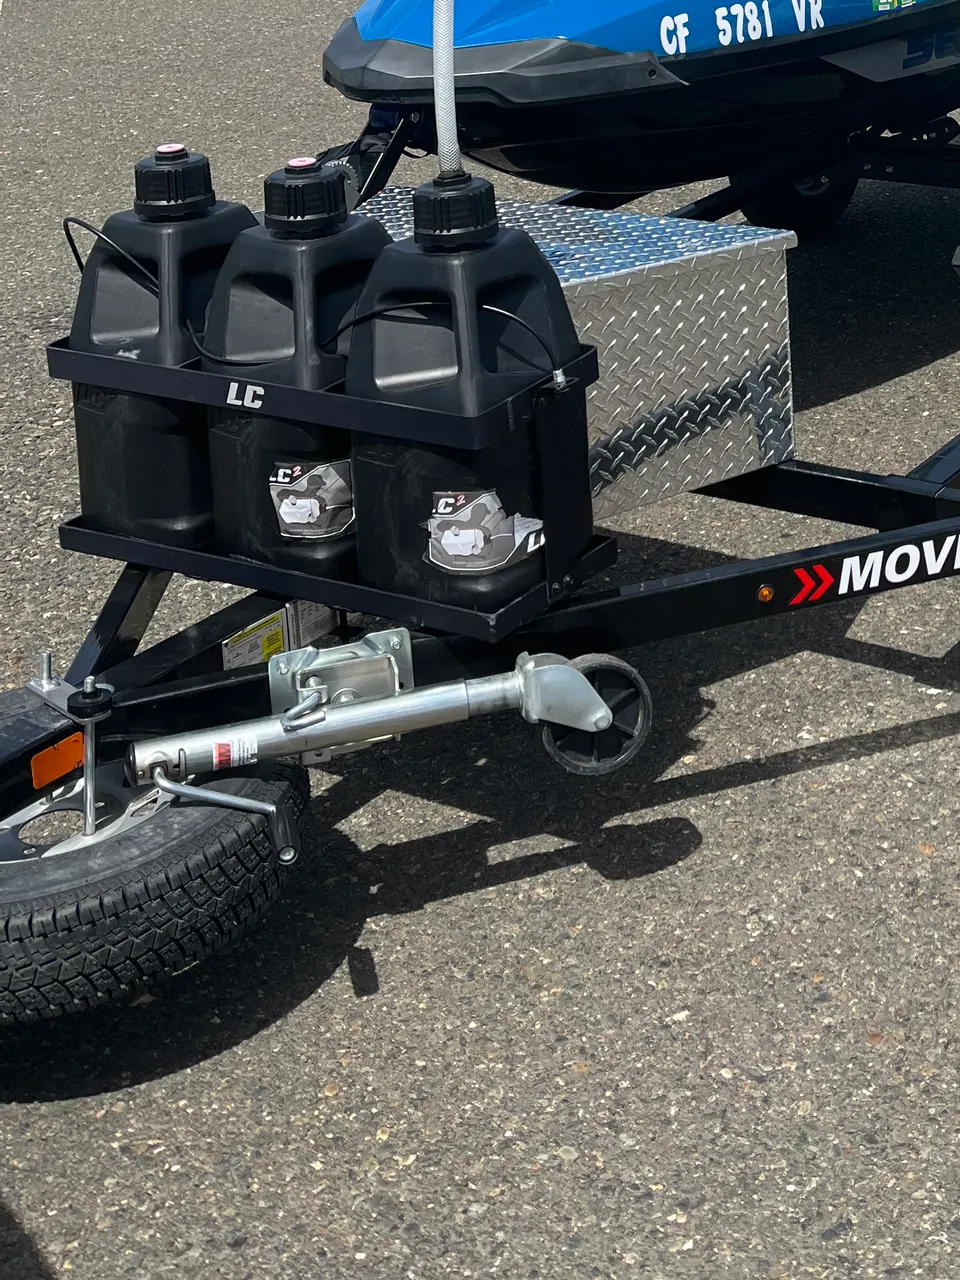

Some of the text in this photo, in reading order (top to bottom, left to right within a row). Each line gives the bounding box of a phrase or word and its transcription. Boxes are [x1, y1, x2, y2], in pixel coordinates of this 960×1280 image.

[660, 12, 690, 55] CF
[714, 0, 773, 46] 5781
[226, 381, 265, 409] LC
